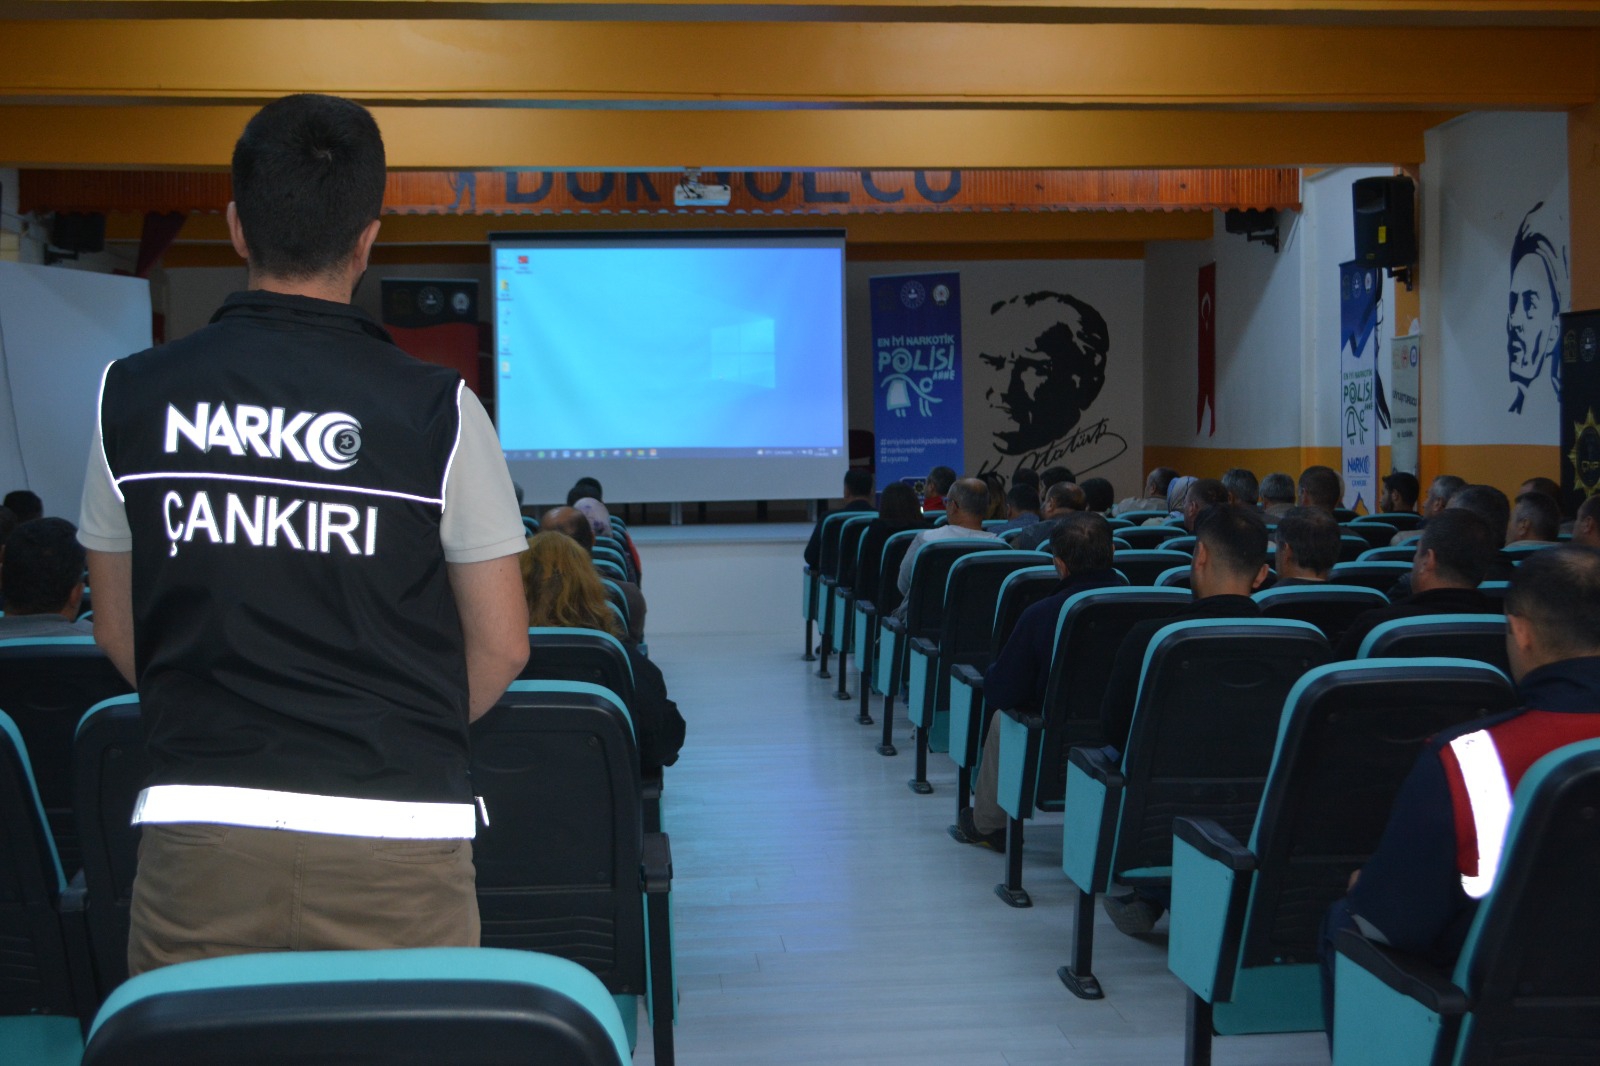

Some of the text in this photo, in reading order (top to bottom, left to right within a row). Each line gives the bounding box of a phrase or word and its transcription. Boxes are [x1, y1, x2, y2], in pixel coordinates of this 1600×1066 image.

[878, 337, 890, 347] EN
[906, 332, 955, 346] NARKOTİK
[164, 490, 378, 557] ÇANKIRI
